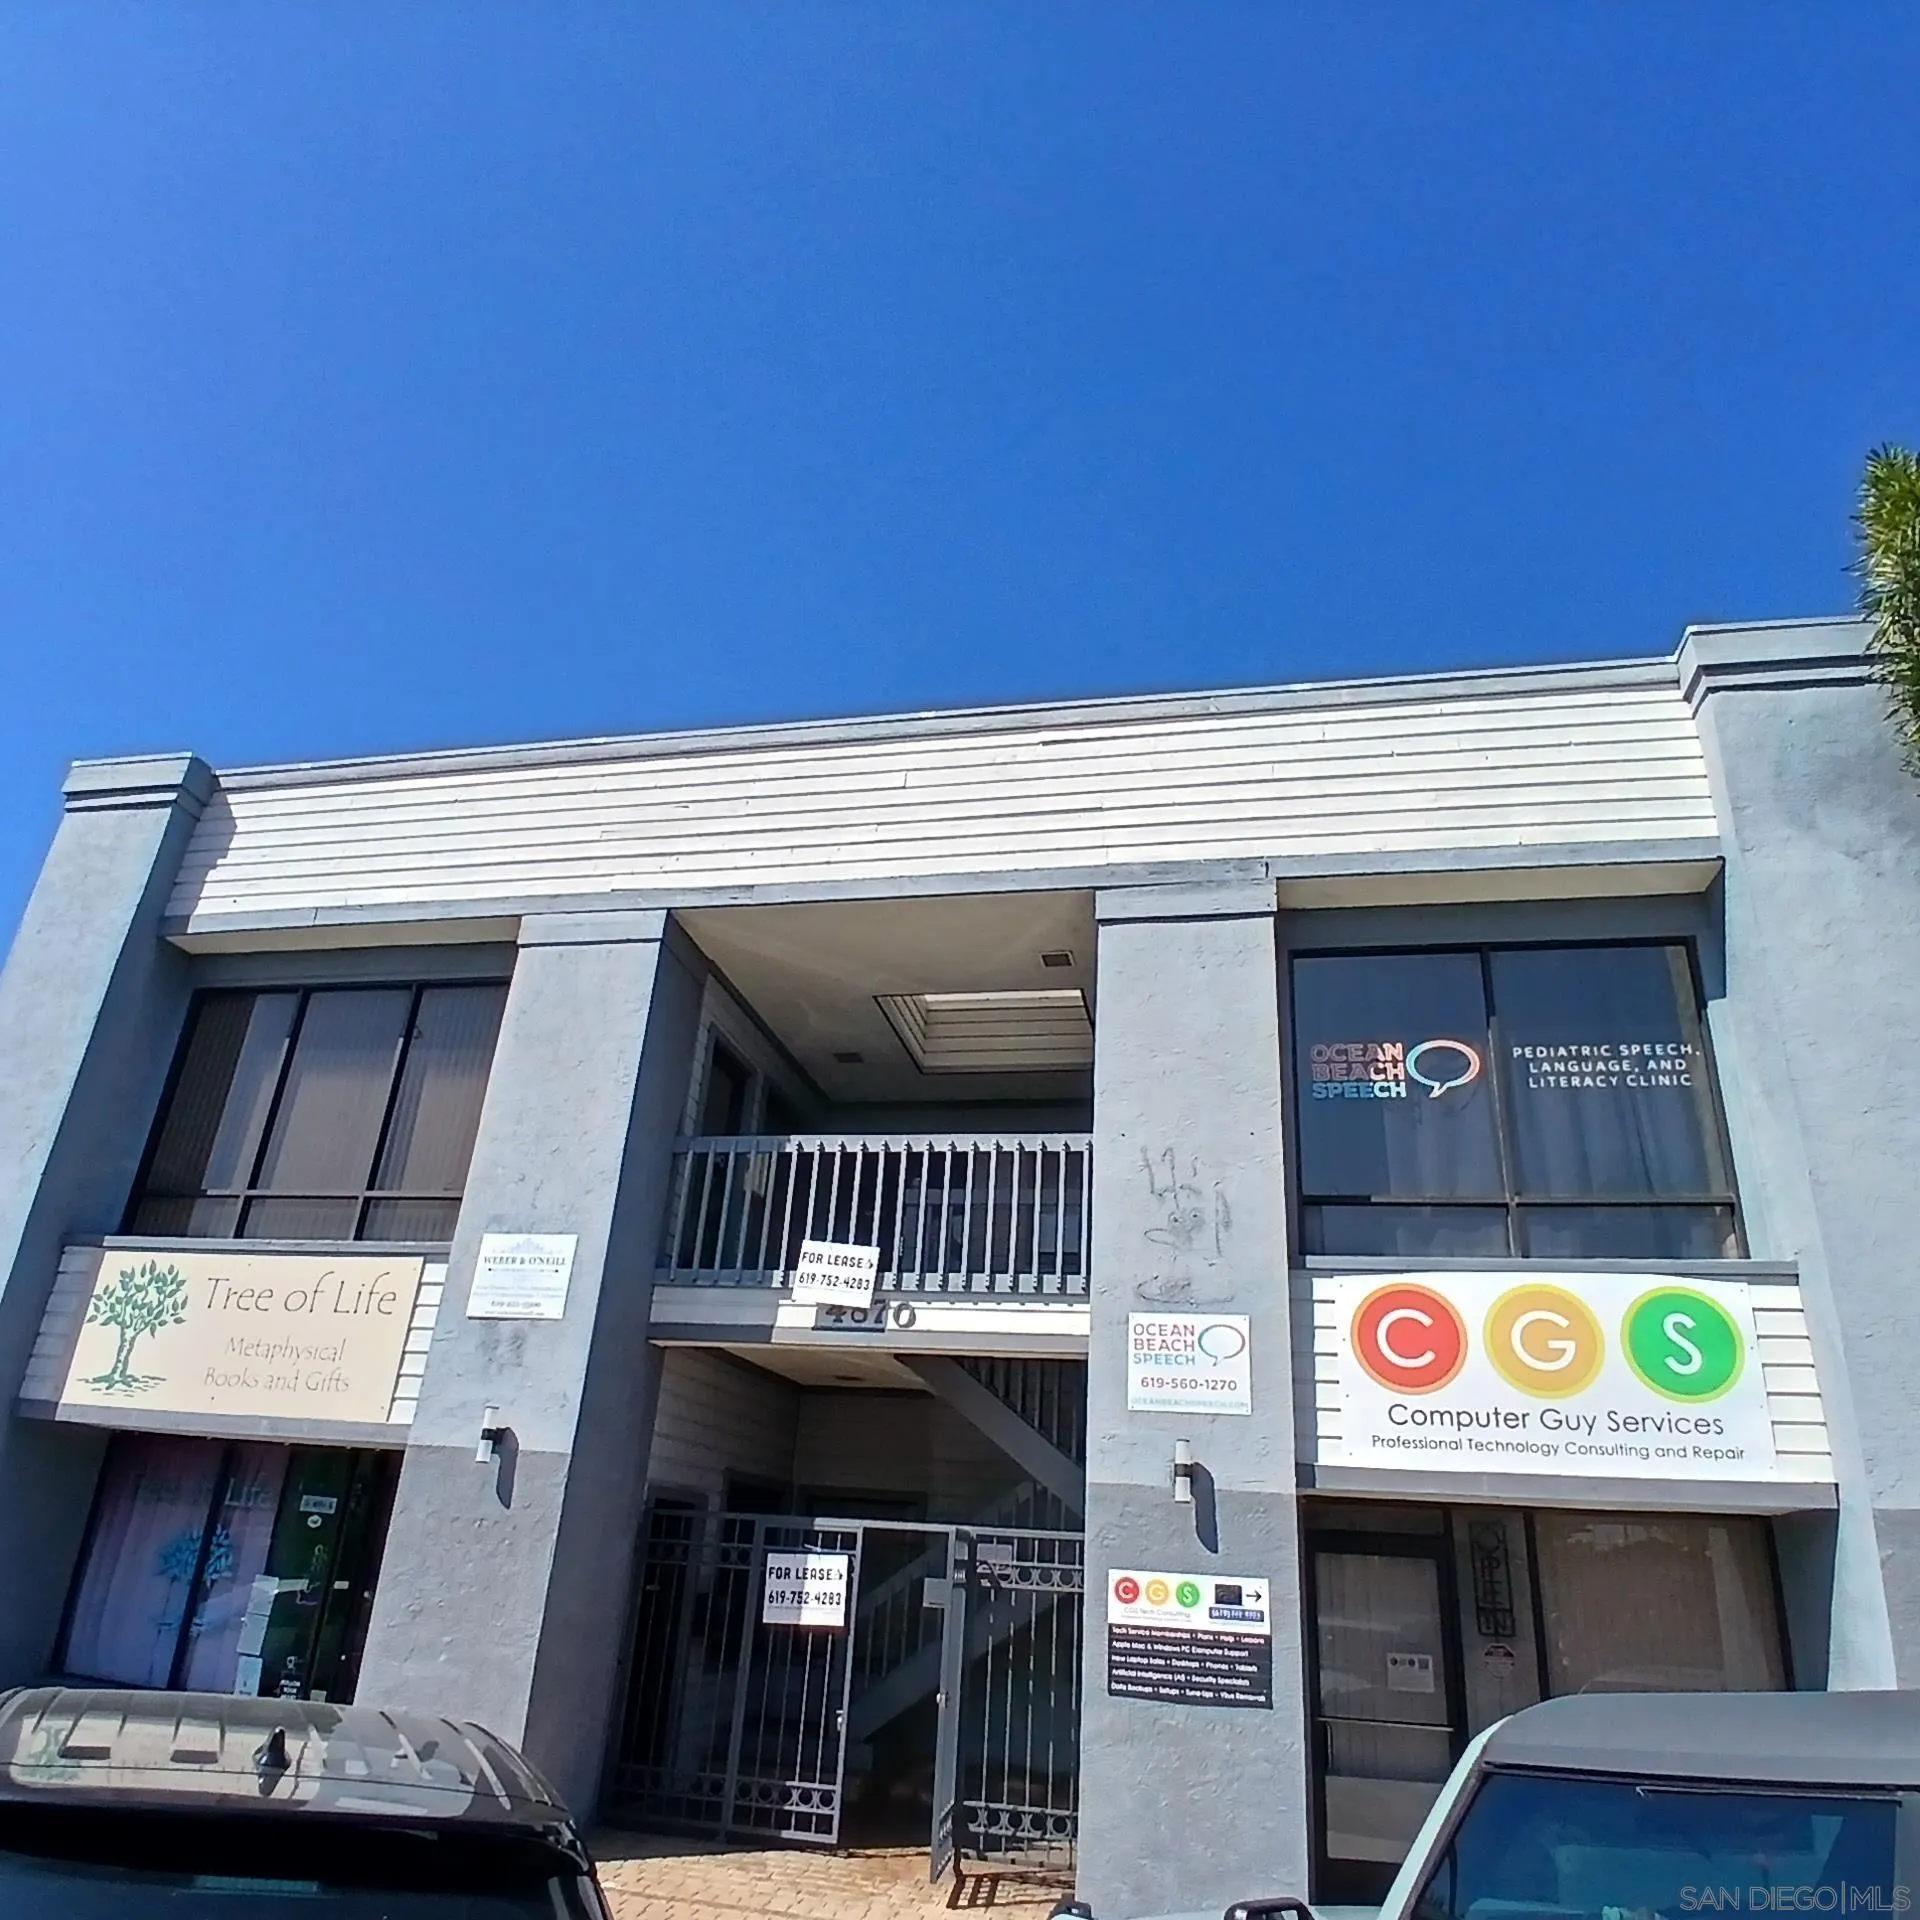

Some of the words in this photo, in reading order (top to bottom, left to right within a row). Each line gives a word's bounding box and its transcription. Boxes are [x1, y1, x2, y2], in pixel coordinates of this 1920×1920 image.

[1311, 1043, 1404, 1062] OCEAN
[1513, 1045, 1611, 1058] PEDIATRIC
[1311, 1062, 1405, 1081] BEACH
[1529, 1060, 1639, 1073] LANGUAGE,
[1647, 1059, 1687, 1071] AND
[1312, 1081, 1407, 1098] SPEECH
[1528, 1075, 1619, 1088] LITERACY
[1626, 1074, 1693, 1087] CLINIC
[801, 1252, 824, 1264] FOR
[827, 1254, 864, 1269] LEASE
[799, 1272, 870, 1291] 619-752-4283
[207, 1277, 274, 1312] Tree
[284, 1271, 335, 1313] of
[333, 1271, 397, 1315] Life
[1133, 1323, 1195, 1337] OCEAN
[225, 1335, 347, 1365] Metaphysical
[1133, 1338, 1195, 1352] BEACH
[1133, 1353, 1196, 1366] SPEECH
[204, 1366, 258, 1389] Books
[264, 1369, 299, 1392] and
[305, 1366, 350, 1393] Gifts
[1140, 1376, 1238, 1391] 619-560-1270
[1387, 1403, 1530, 1432] Computer
[1540, 1407, 1598, 1436] Guy
[1606, 1409, 1724, 1436] Services
[1371, 1434, 1464, 1452] Professional
[1467, 1437, 1560, 1457] Technology
[1564, 1441, 1650, 1461] Consulting
[1654, 1444, 1688, 1459] and
[1692, 1445, 1745, 1462] Repair
[768, 1567, 791, 1580] FOR
[796, 1567, 833, 1580] LEASE
[768, 1590, 842, 1605] 619-752-4283
